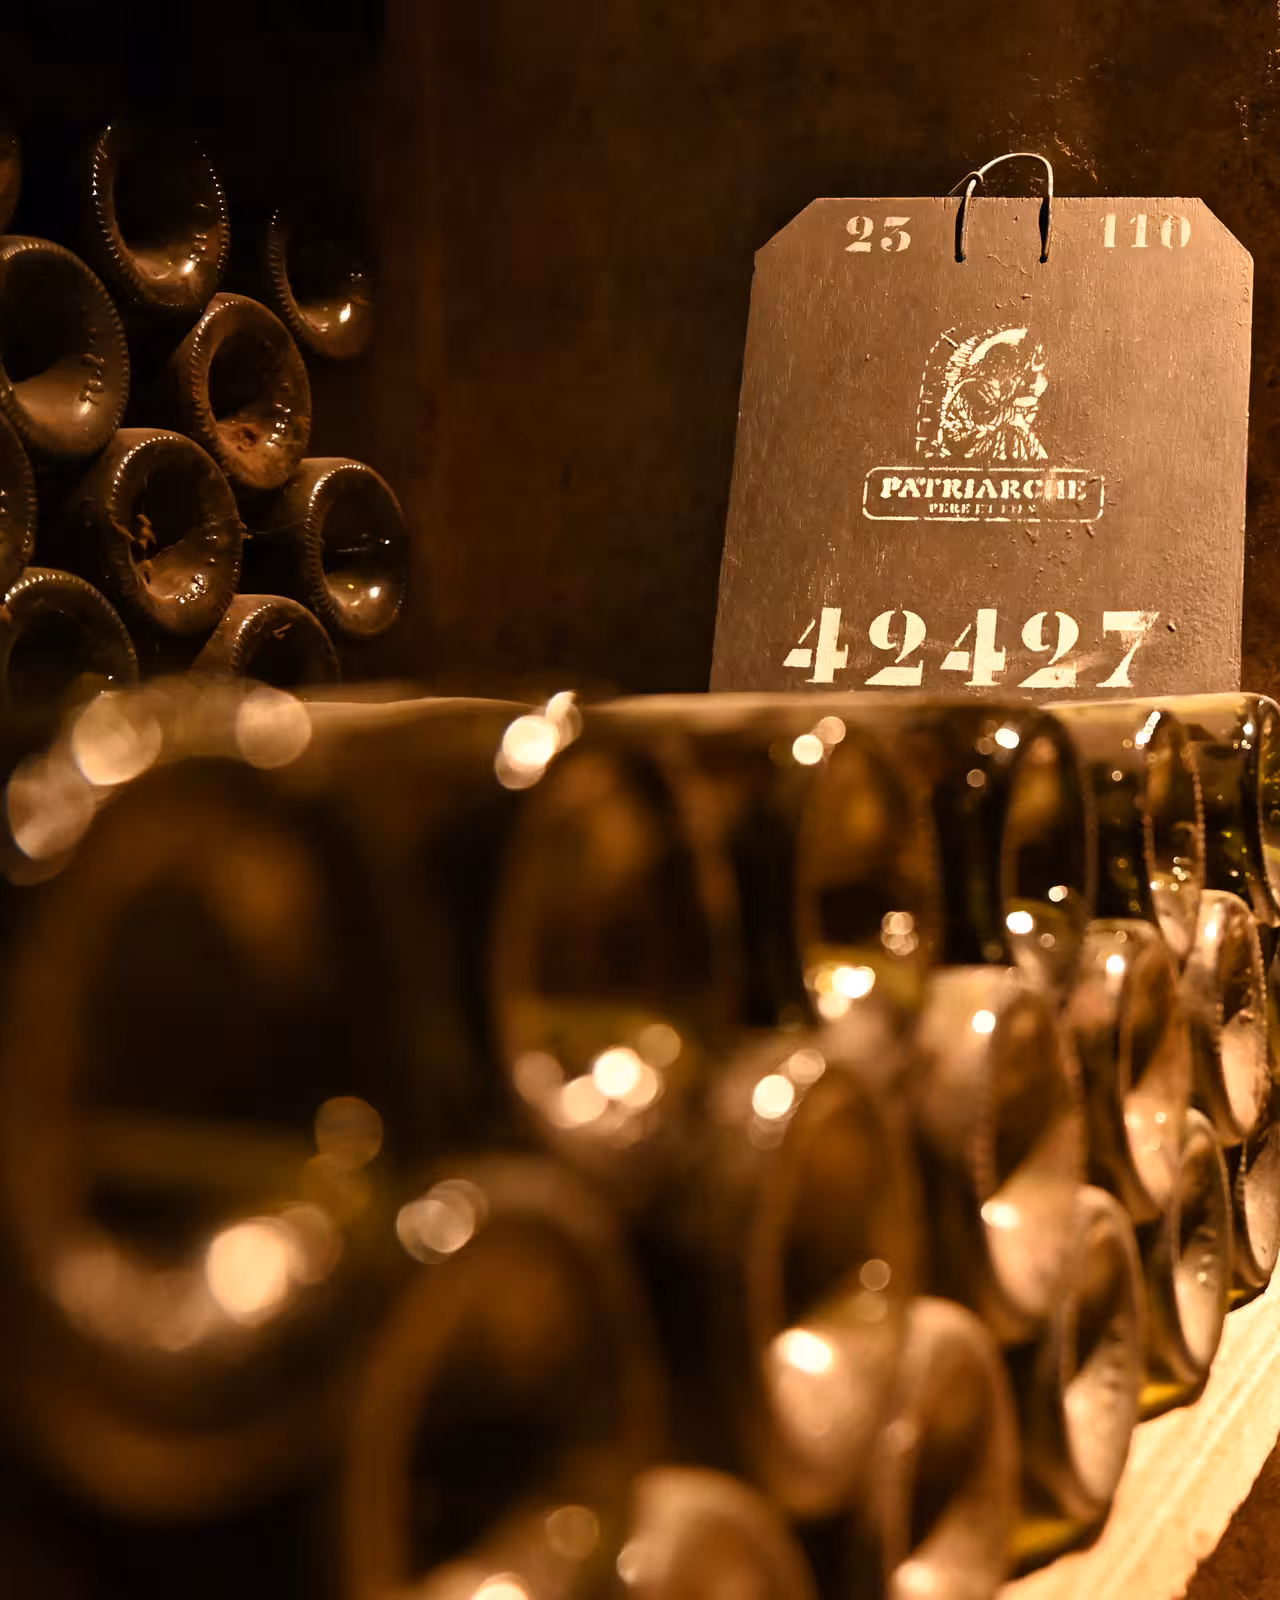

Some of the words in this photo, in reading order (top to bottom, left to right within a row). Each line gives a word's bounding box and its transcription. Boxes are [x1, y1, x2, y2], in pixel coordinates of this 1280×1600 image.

[1099, 213, 1190, 249] 110
[880, 476, 1086, 500] PATRIARCHE
[782, 606, 1160, 688] 42427
